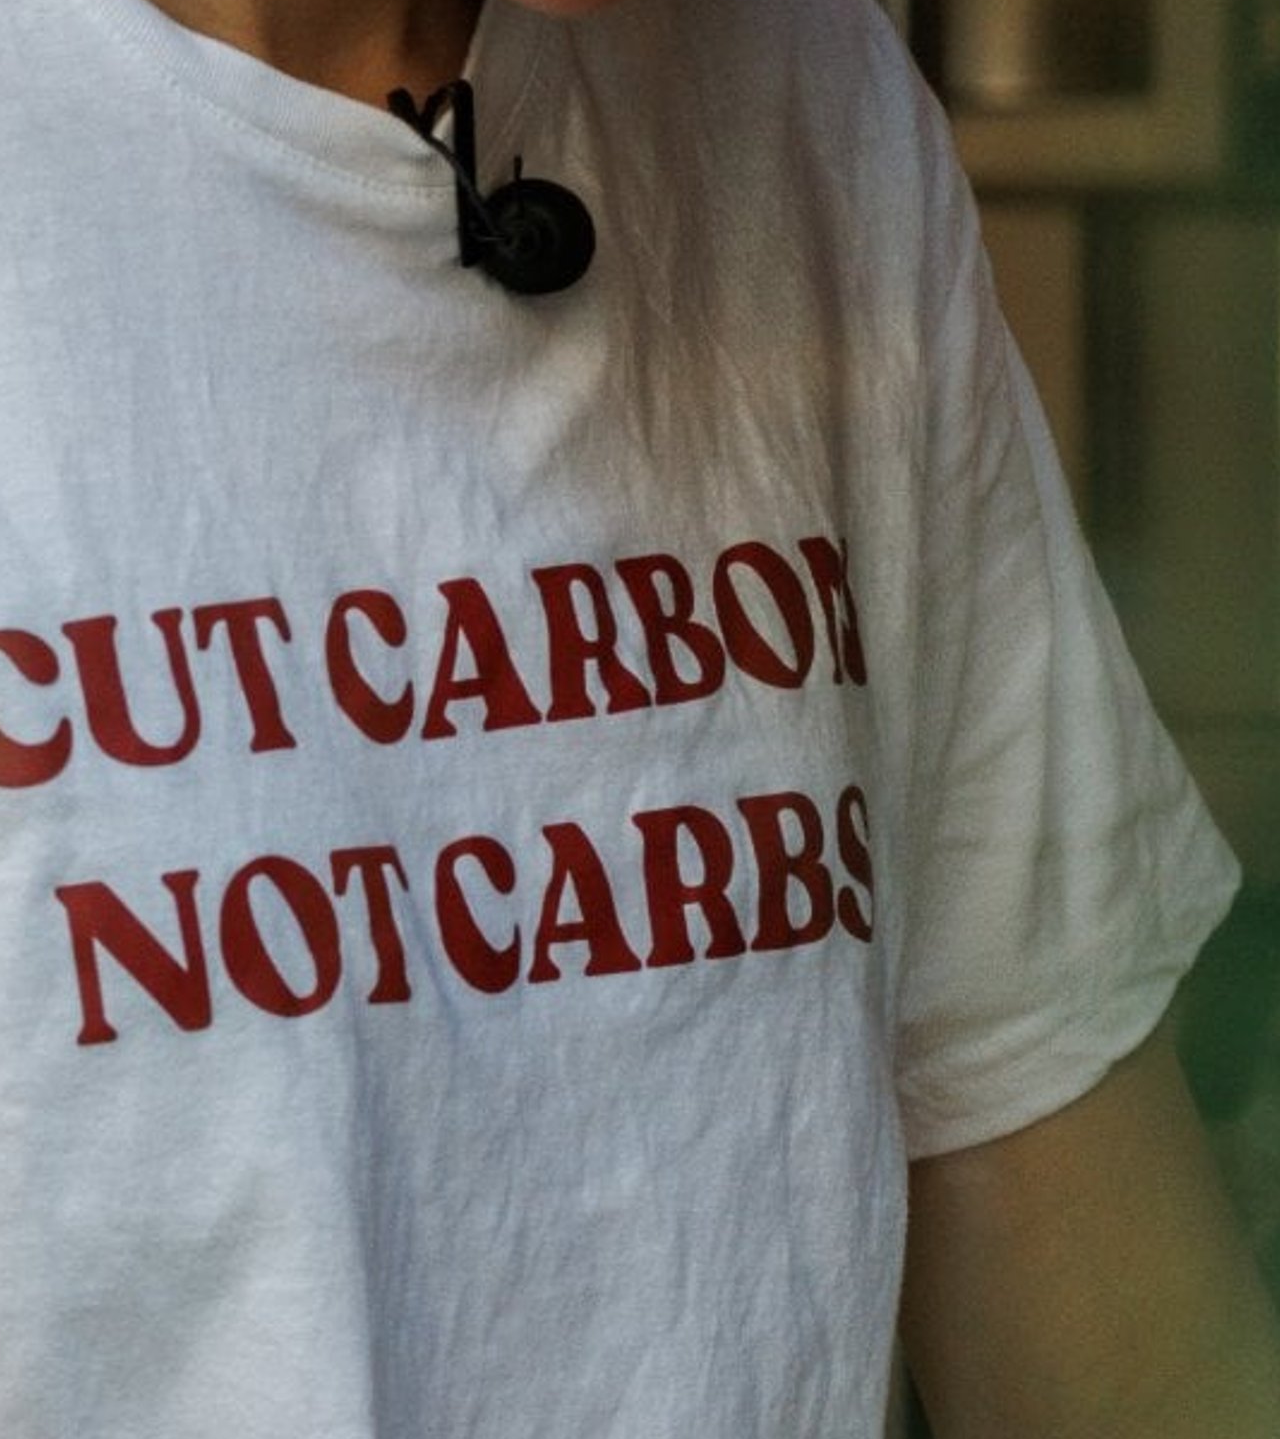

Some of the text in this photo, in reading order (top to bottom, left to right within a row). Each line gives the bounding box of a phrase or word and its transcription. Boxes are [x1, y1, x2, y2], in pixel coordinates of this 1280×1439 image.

[324, 536, 869, 744] CARBON
[55, 785, 874, 1046] NOT CARBS
